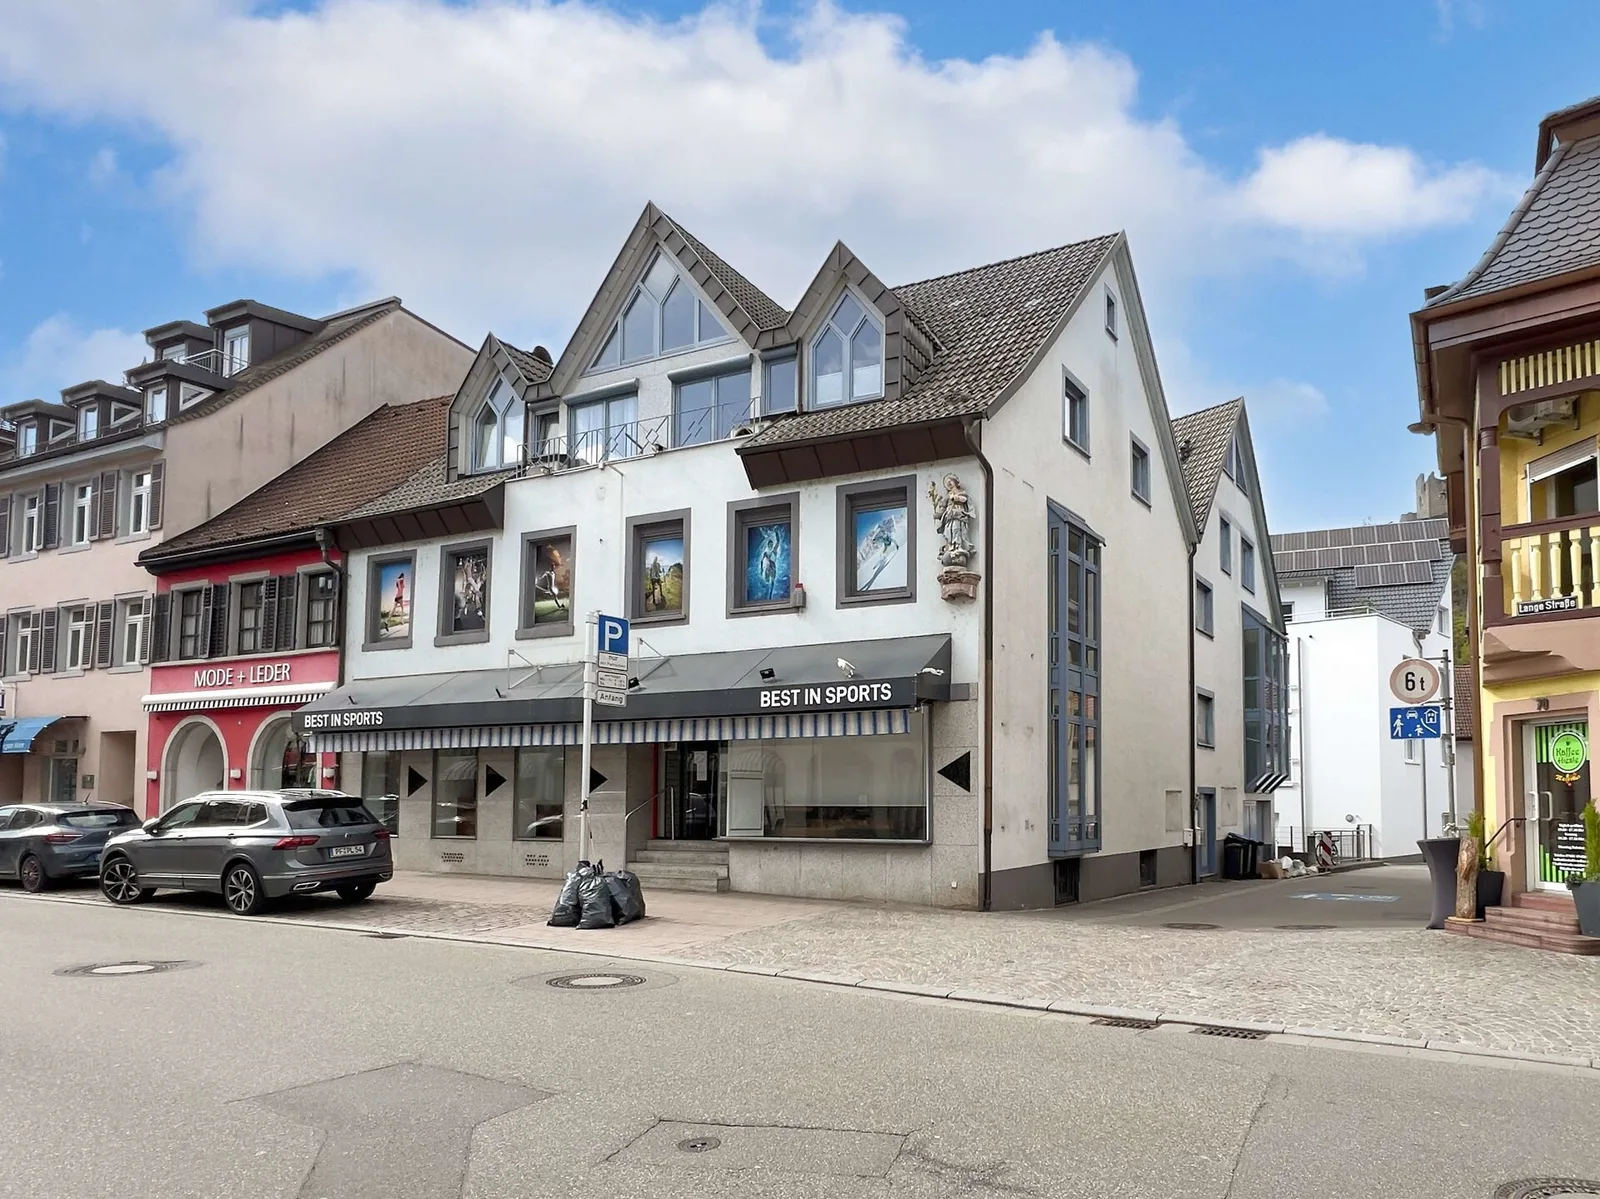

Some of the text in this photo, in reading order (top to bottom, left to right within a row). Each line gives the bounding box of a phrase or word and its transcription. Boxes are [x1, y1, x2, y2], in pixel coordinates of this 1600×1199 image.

[1519, 598, 1576, 613] Lange Straße
[605, 621, 622, 650] P
[193, 667, 234, 688] MODE
[250, 663, 291, 685] LEDER
[600, 693, 623, 704] Anfang
[760, 682, 893, 708] BEST IN SPORTS
[304, 710, 384, 729] BEST IN SPORTS
